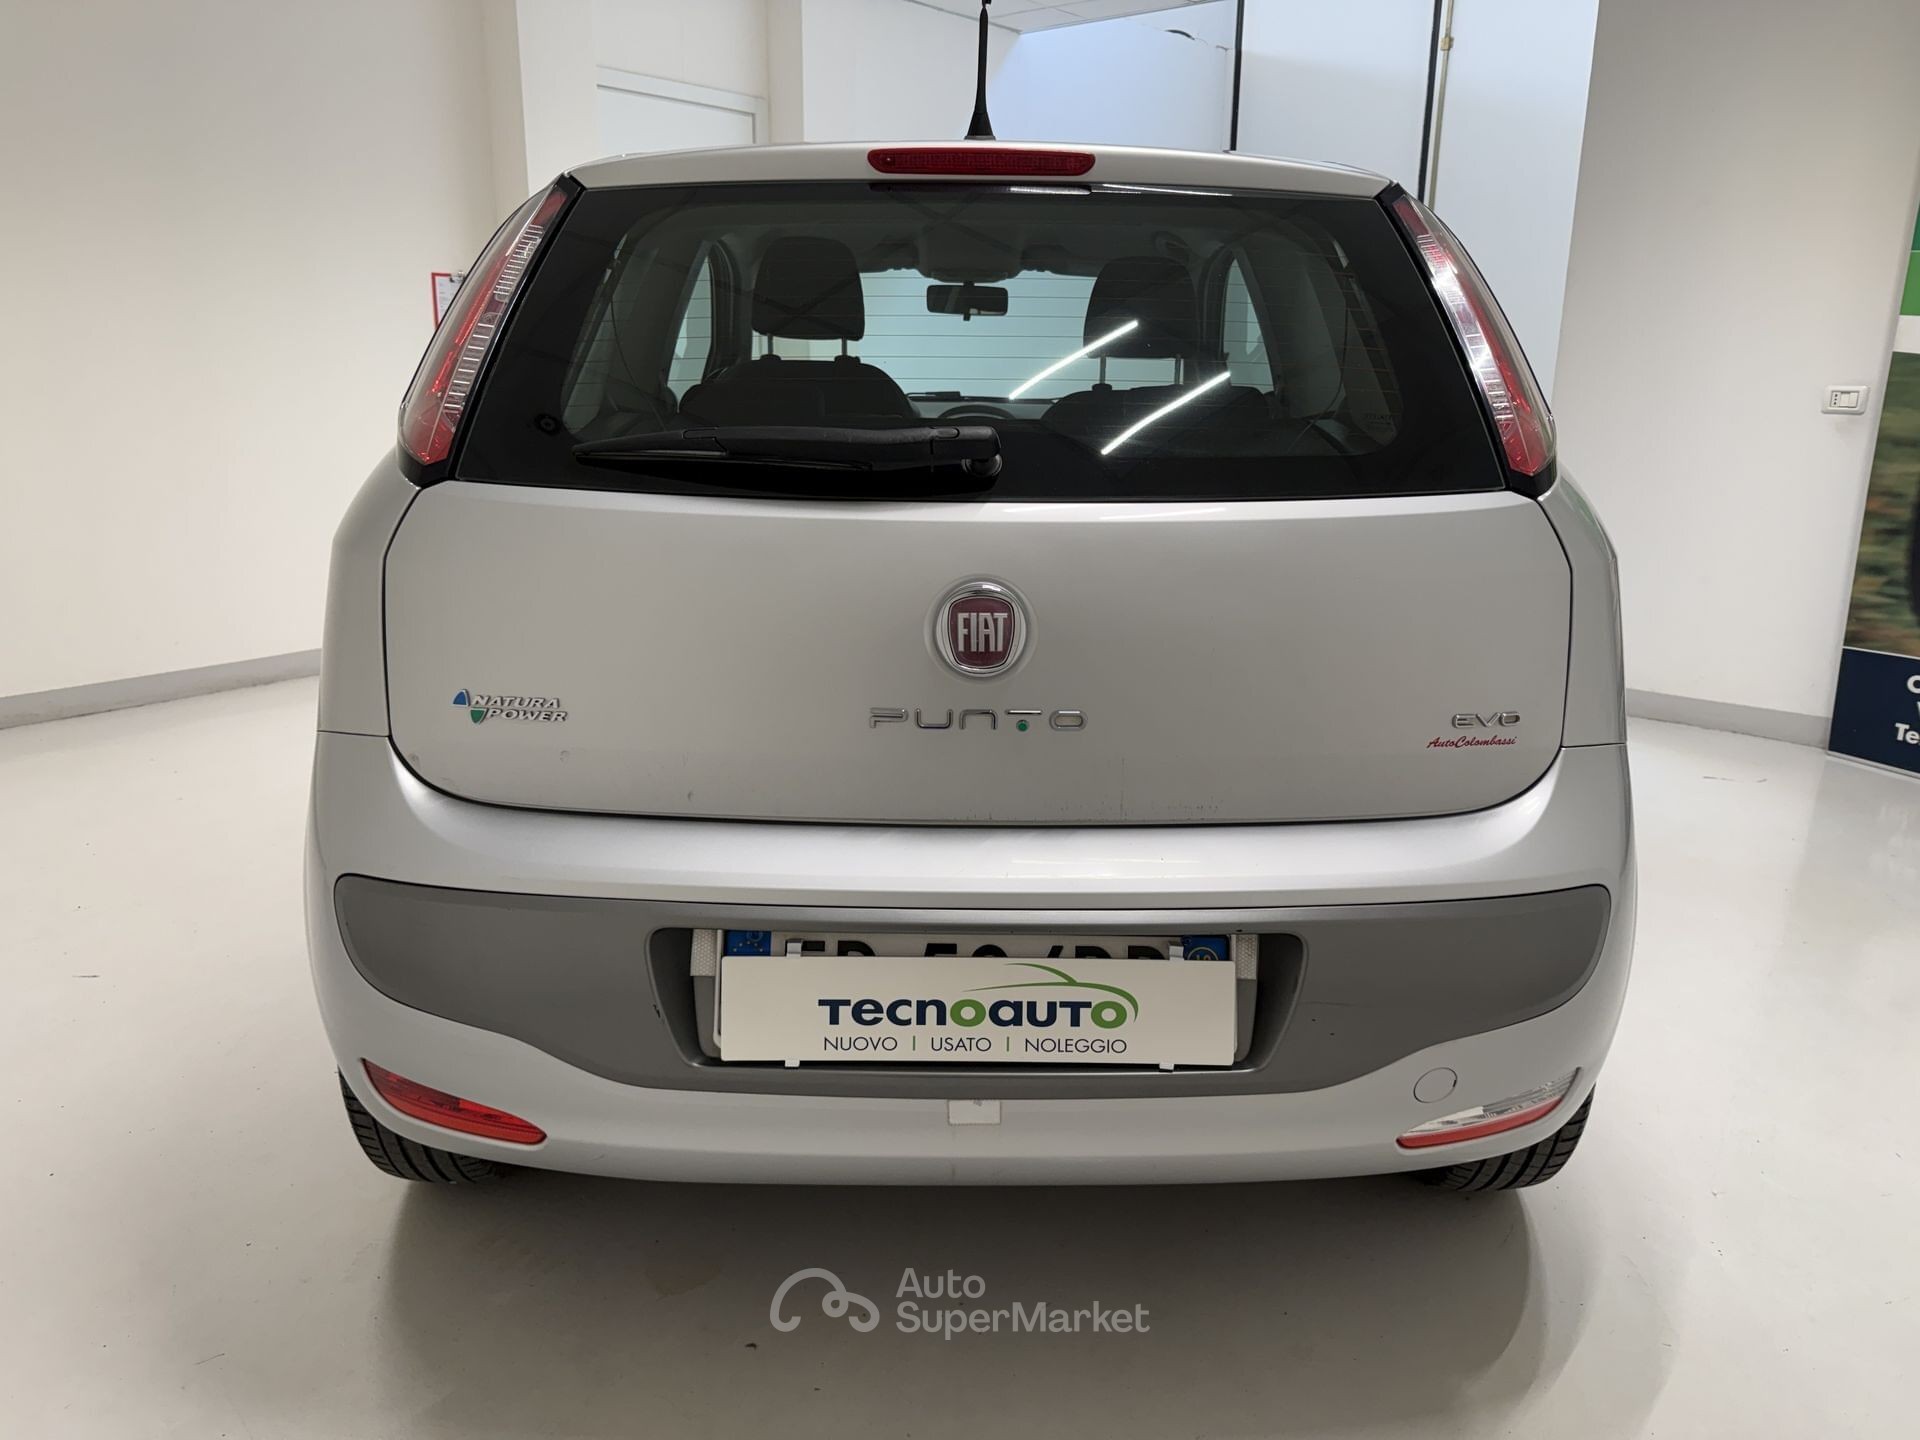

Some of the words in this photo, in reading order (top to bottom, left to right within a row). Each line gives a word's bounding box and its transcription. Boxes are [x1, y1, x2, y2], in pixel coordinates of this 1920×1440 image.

[957, 612, 1009, 652] FIAT
[471, 695, 561, 709] NATURA
[486, 707, 568, 722] POWER
[869, 707, 1088, 731] PUNTO
[1452, 711, 1521, 729] EVO
[1426, 734, 1518, 749] AutoColombassi
[1894, 722, 1920, 745] Te
[823, 1036, 899, 1052] NUOVO
[930, 1036, 992, 1052] USATO
[1024, 1037, 1128, 1054] NOLEGGIO
